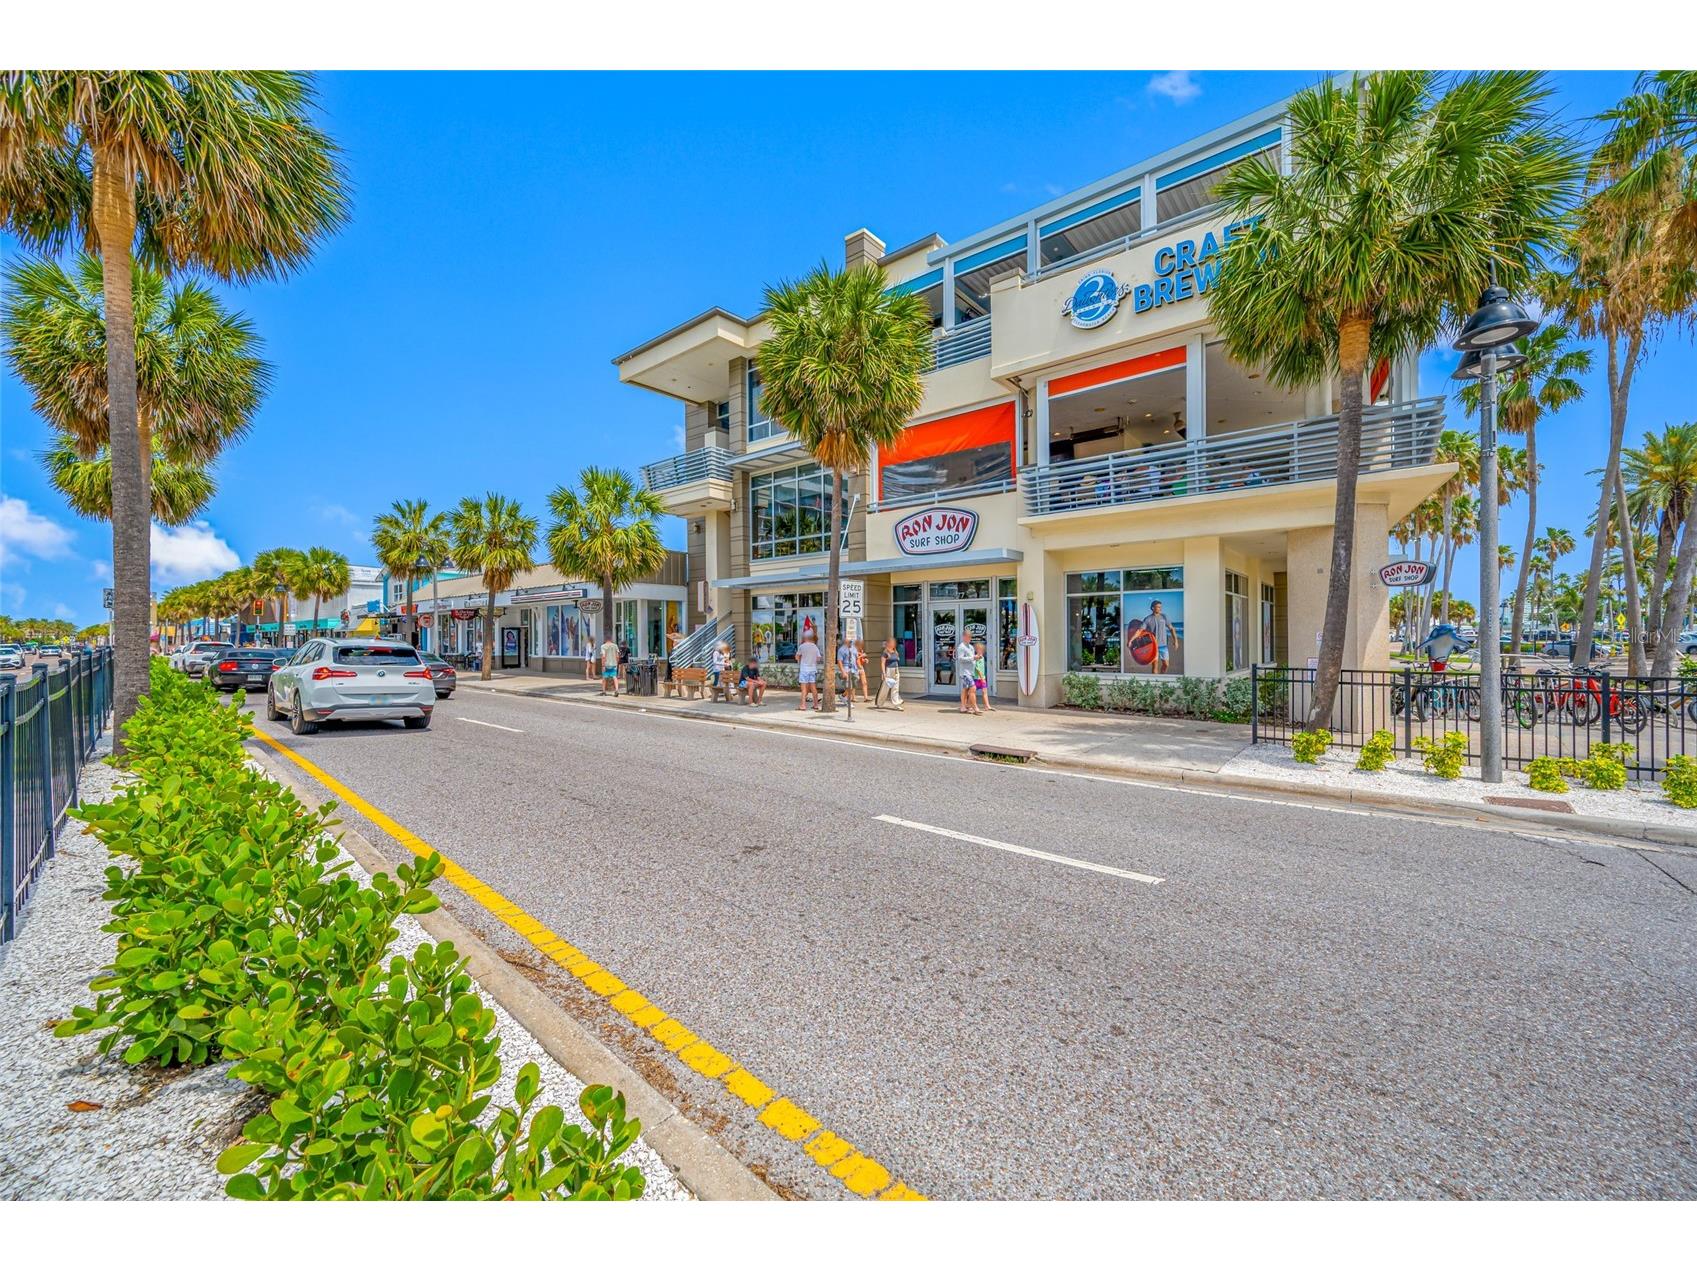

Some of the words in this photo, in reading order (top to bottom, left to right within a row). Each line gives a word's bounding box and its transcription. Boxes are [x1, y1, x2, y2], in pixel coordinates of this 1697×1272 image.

[902, 514, 933, 541] RON
[936, 514, 970, 533] JON
[909, 536, 931, 549] SURF
[934, 533, 960, 546] SHOP
[1384, 565, 1402, 578] RON
[1404, 564, 1424, 574] JON
[842, 600, 861, 614] 25
